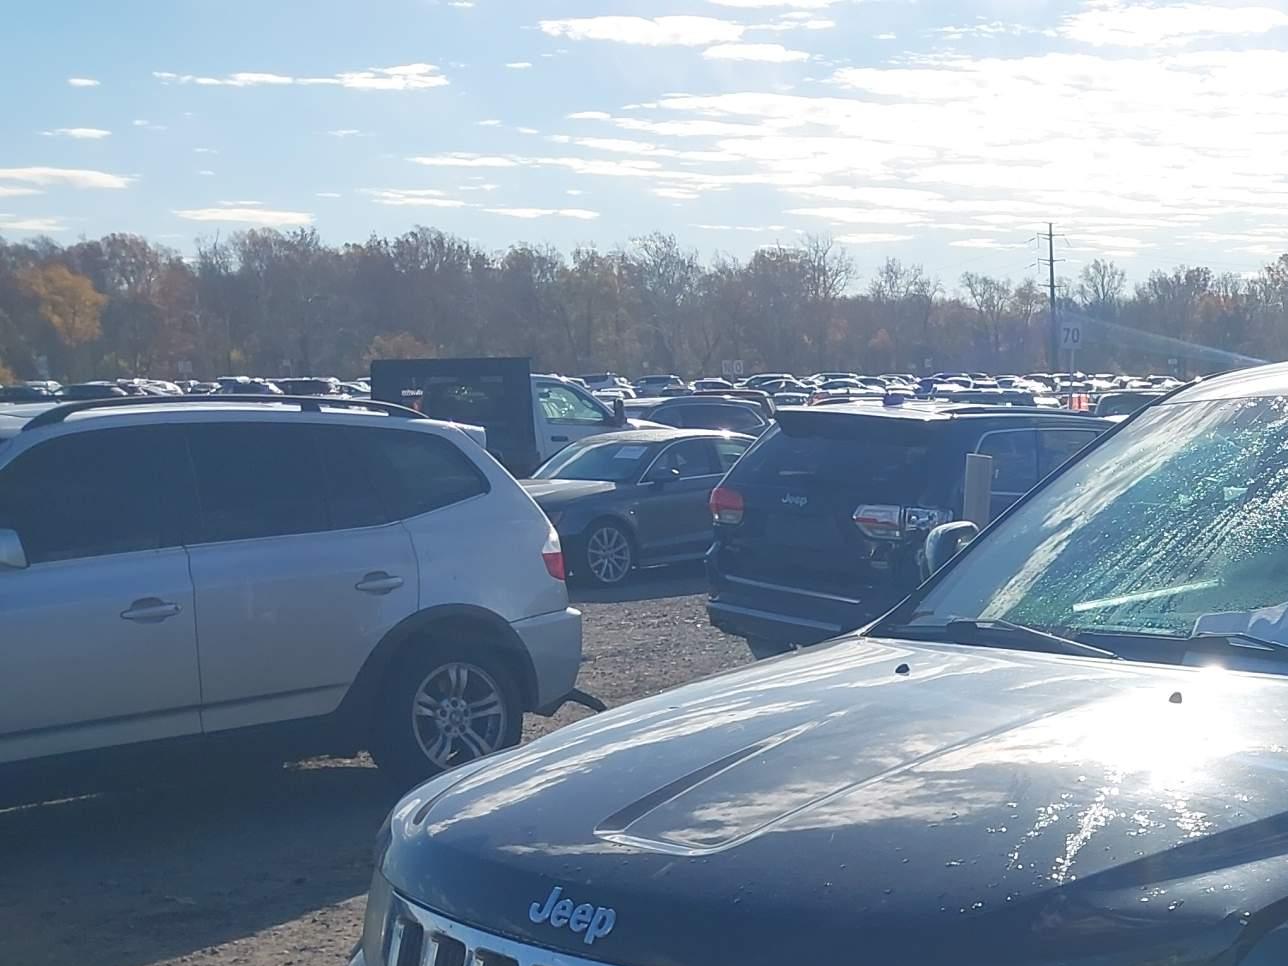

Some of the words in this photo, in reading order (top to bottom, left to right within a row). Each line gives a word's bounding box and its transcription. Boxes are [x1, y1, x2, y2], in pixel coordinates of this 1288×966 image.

[1063, 327, 1080, 344] 70
[782, 493, 807, 507] Jeep
[528, 886, 616, 945] Jeep
